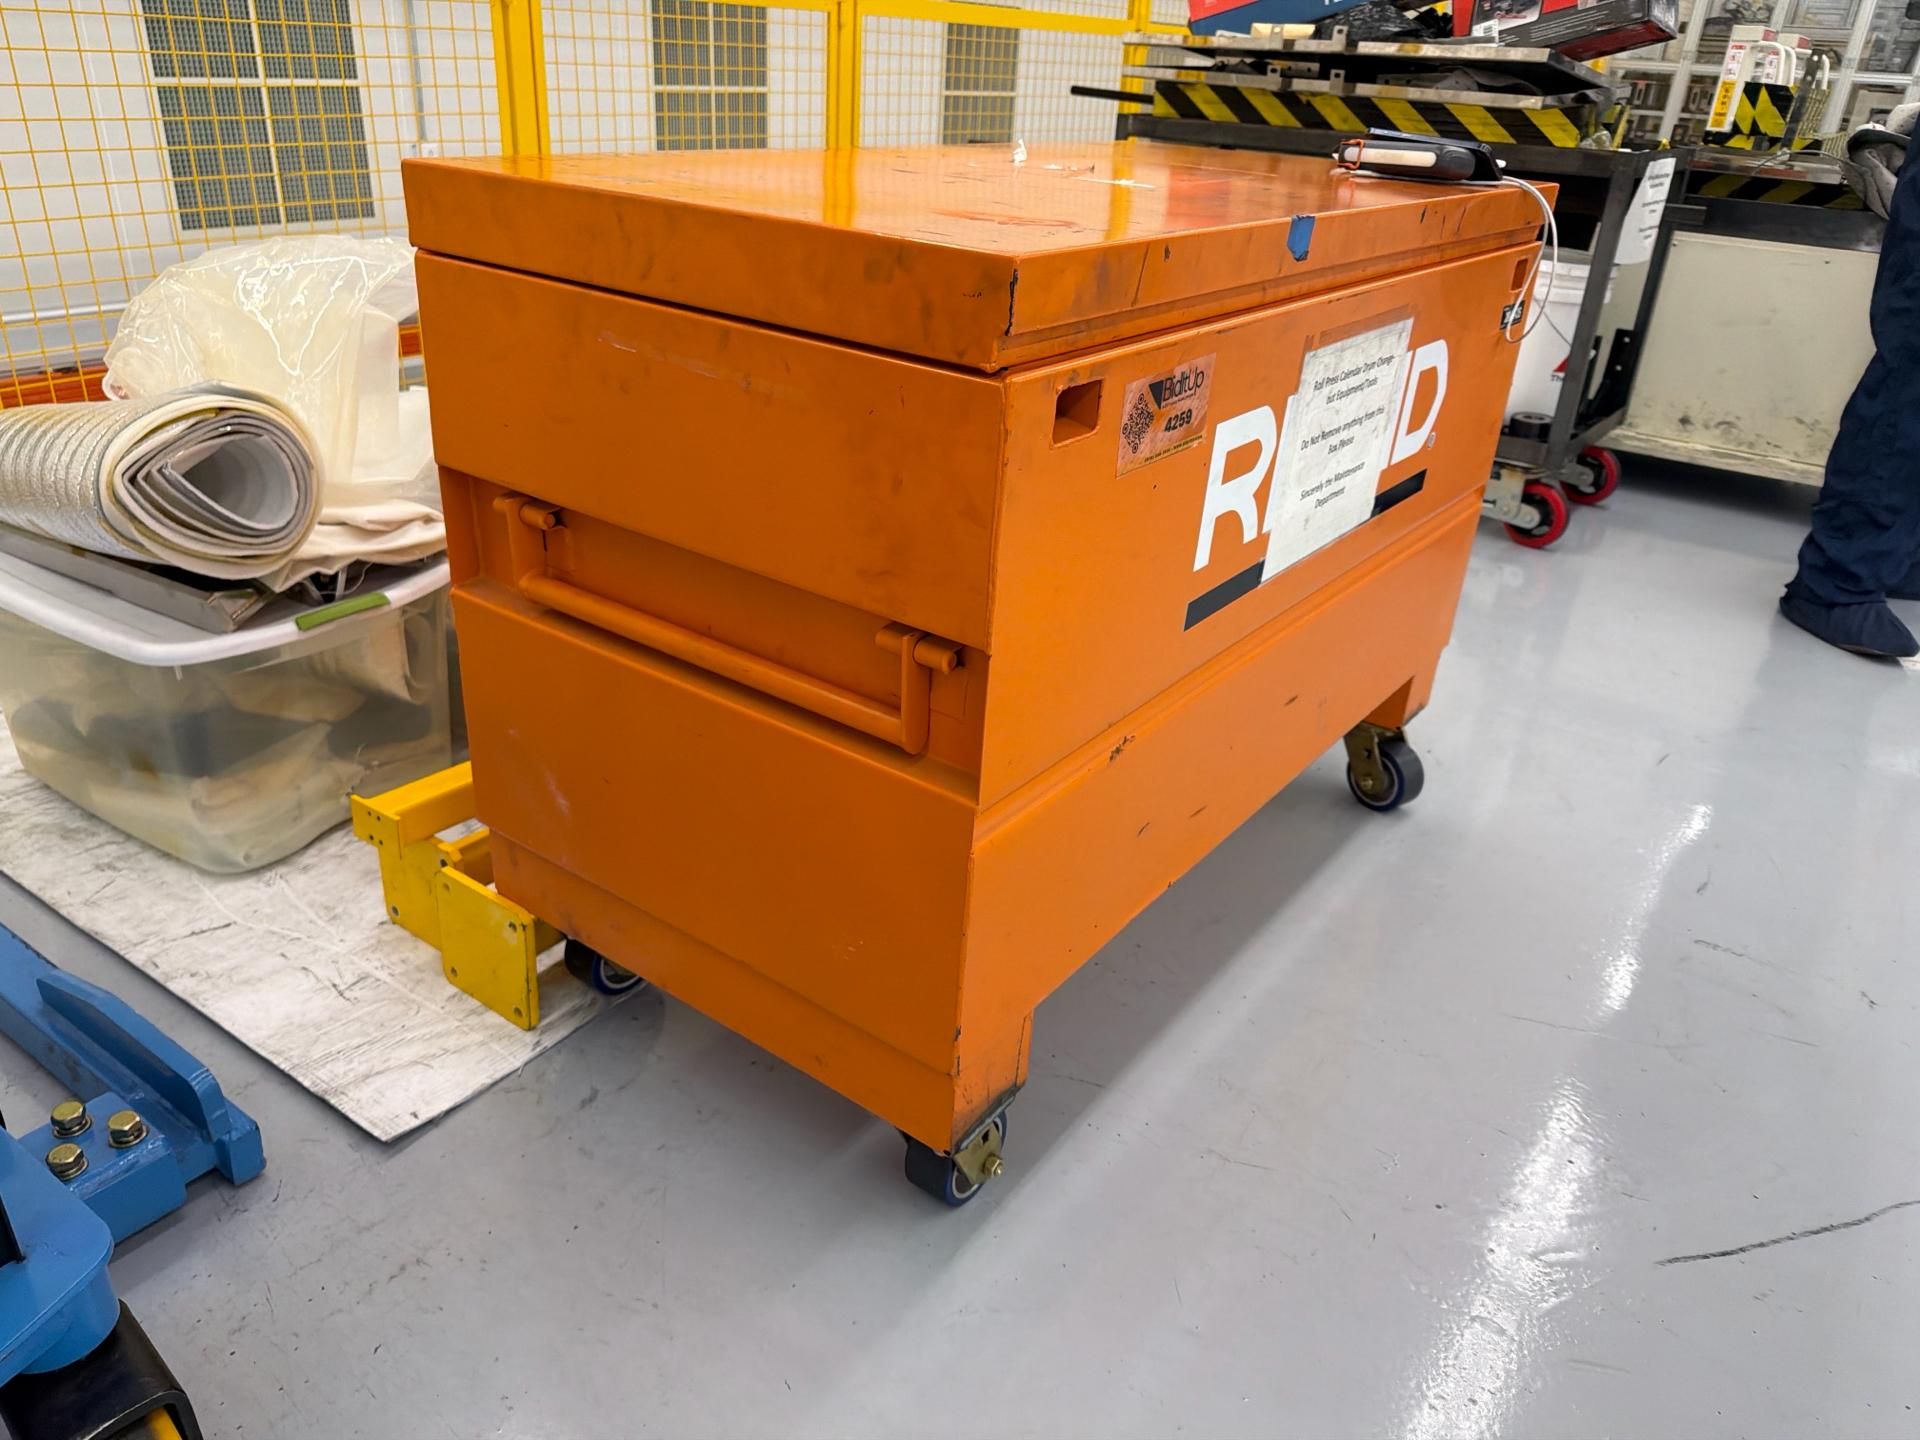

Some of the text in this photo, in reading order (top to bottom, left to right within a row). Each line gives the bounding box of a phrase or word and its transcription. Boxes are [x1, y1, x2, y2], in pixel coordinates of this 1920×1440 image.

[1313, 377, 1326, 392] Roll
[1325, 374, 1340, 387] Press
[1340, 365, 1363, 382] Calendar
[1363, 361, 1377, 373] Drum
[1164, 409, 1193, 433] 4259
[1300, 407, 1385, 451] Do Not Remove anything from this
[1328, 436, 1355, 455] Box Please
[1300, 462, 1366, 501] Sincerely the Maintenance
[1314, 487, 1346, 509] Department
